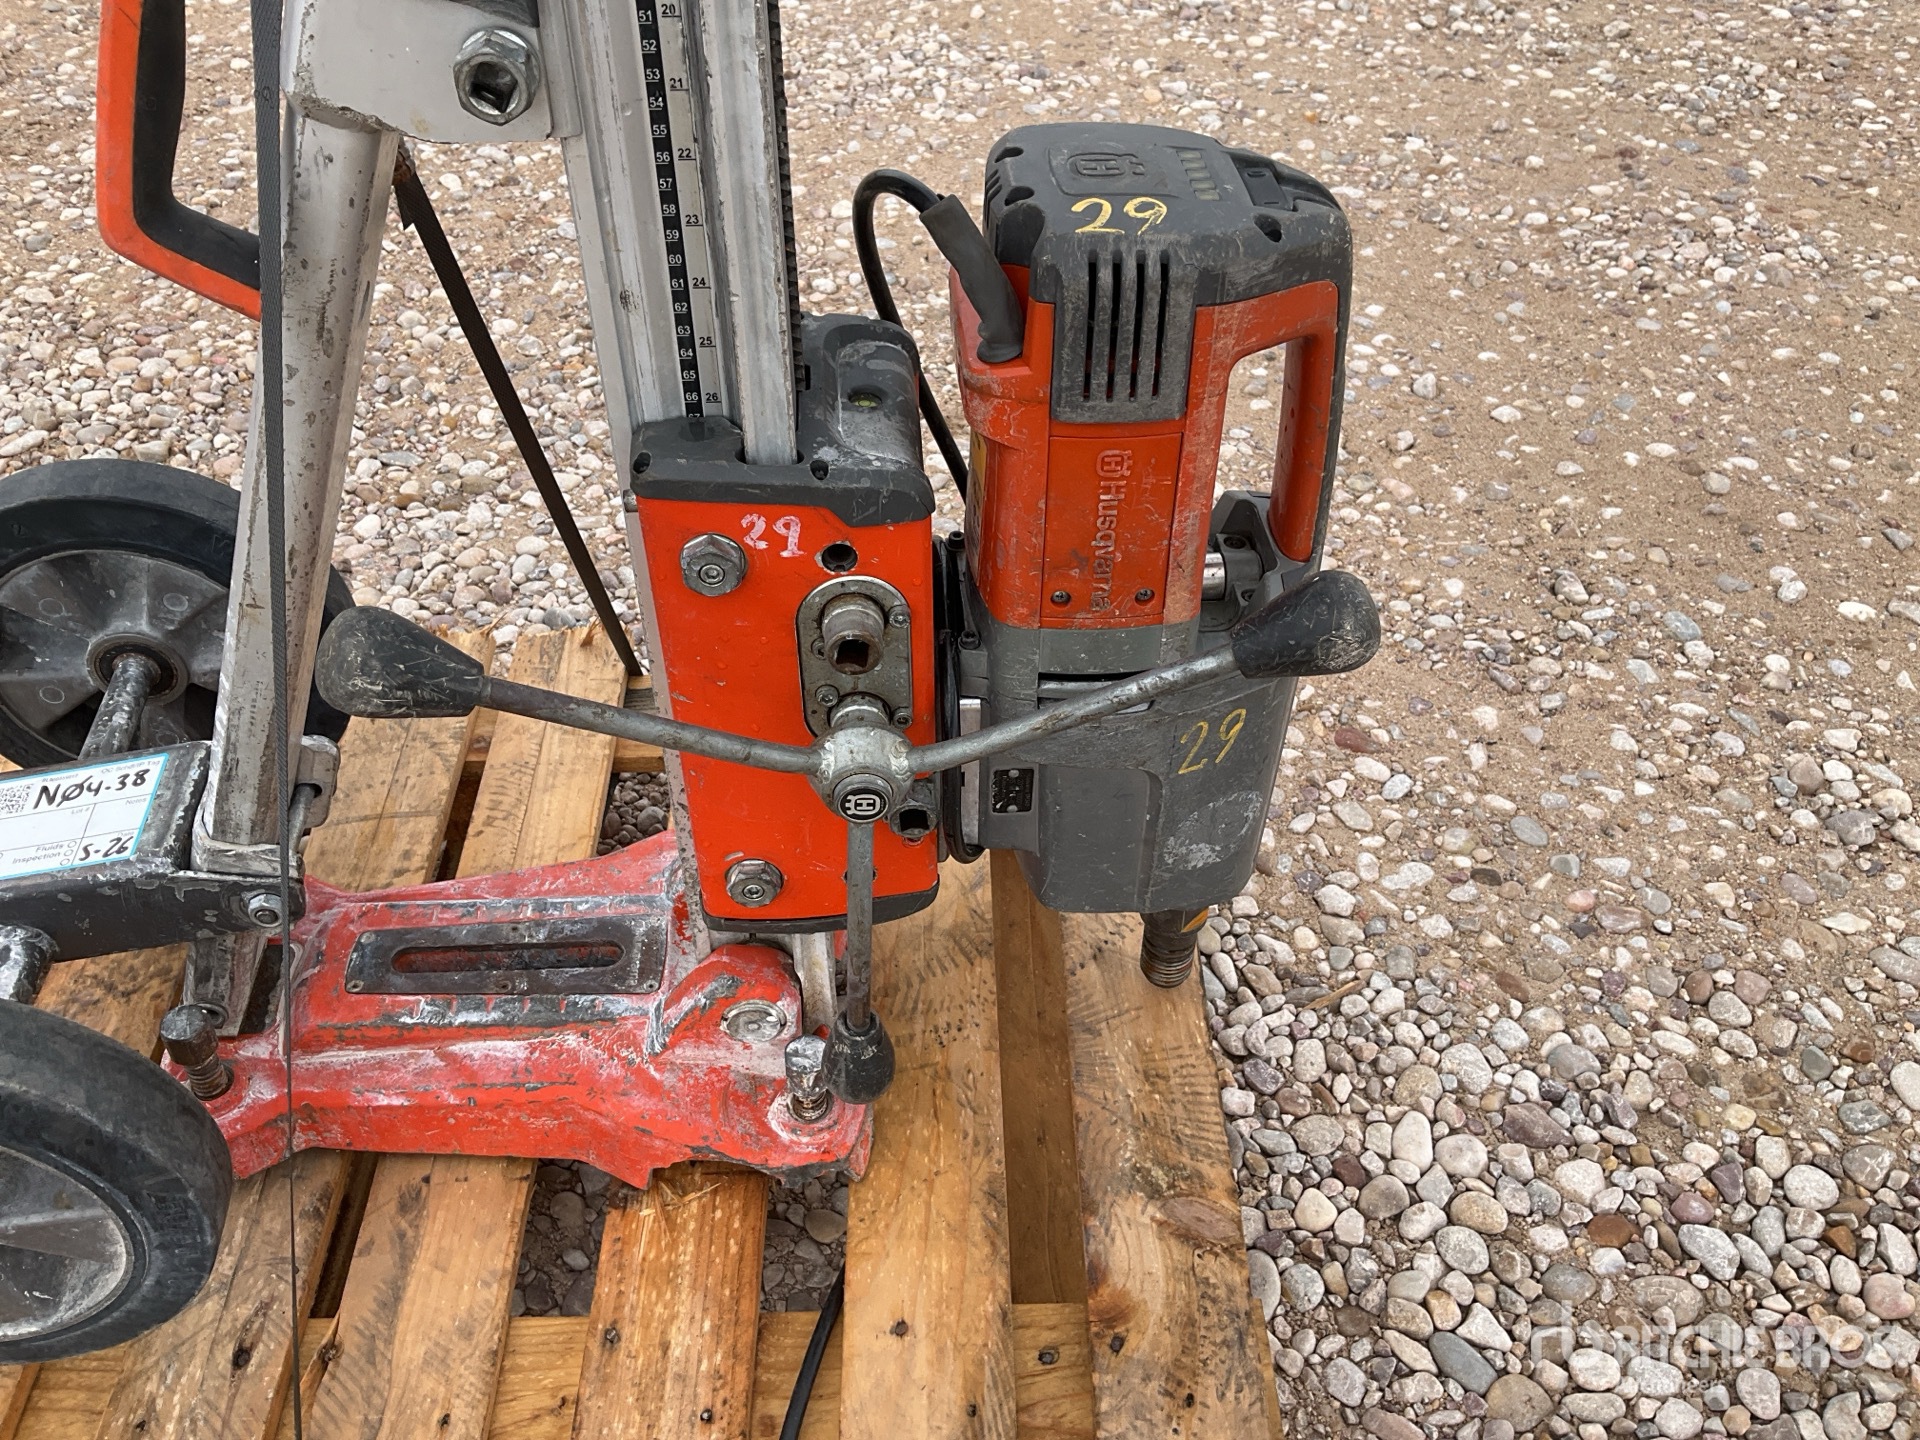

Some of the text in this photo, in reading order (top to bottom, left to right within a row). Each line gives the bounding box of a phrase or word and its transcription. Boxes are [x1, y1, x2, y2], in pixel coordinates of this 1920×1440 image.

[662, 4, 676, 15] 20
[638, 10, 652, 22] 51
[642, 40, 657, 50] 52
[646, 69, 660, 79] 53
[669, 78, 683, 88] 21
[650, 97, 664, 108] 54
[652, 125, 667, 135] 55
[656, 152, 670, 162] 56
[678, 149, 692, 158] 22
[659, 179, 672, 188] 57
[662, 204, 676, 214] 58
[685, 215, 699, 224] 23
[1070, 197, 1168, 236] 29
[666, 230, 680, 239] 59
[668, 254, 682, 264] 60
[672, 279, 684, 288] 61
[692, 278, 706, 286] 24
[674, 302, 688, 312] 62
[678, 326, 690, 334] 63
[700, 336, 712, 345] 25
[680, 348, 693, 357] 64
[682, 370, 696, 378] 65
[686, 392, 698, 400] 66
[706, 392, 718, 401] 26
[739, 513, 807, 557] 29
[1090, 480, 1127, 612] Husqvarna
[1177, 708, 1247, 775] 29
[125, 797, 148, 806] Notes
[35, 842, 65, 853] Fluids
[12, 851, 61, 865] Inspection
